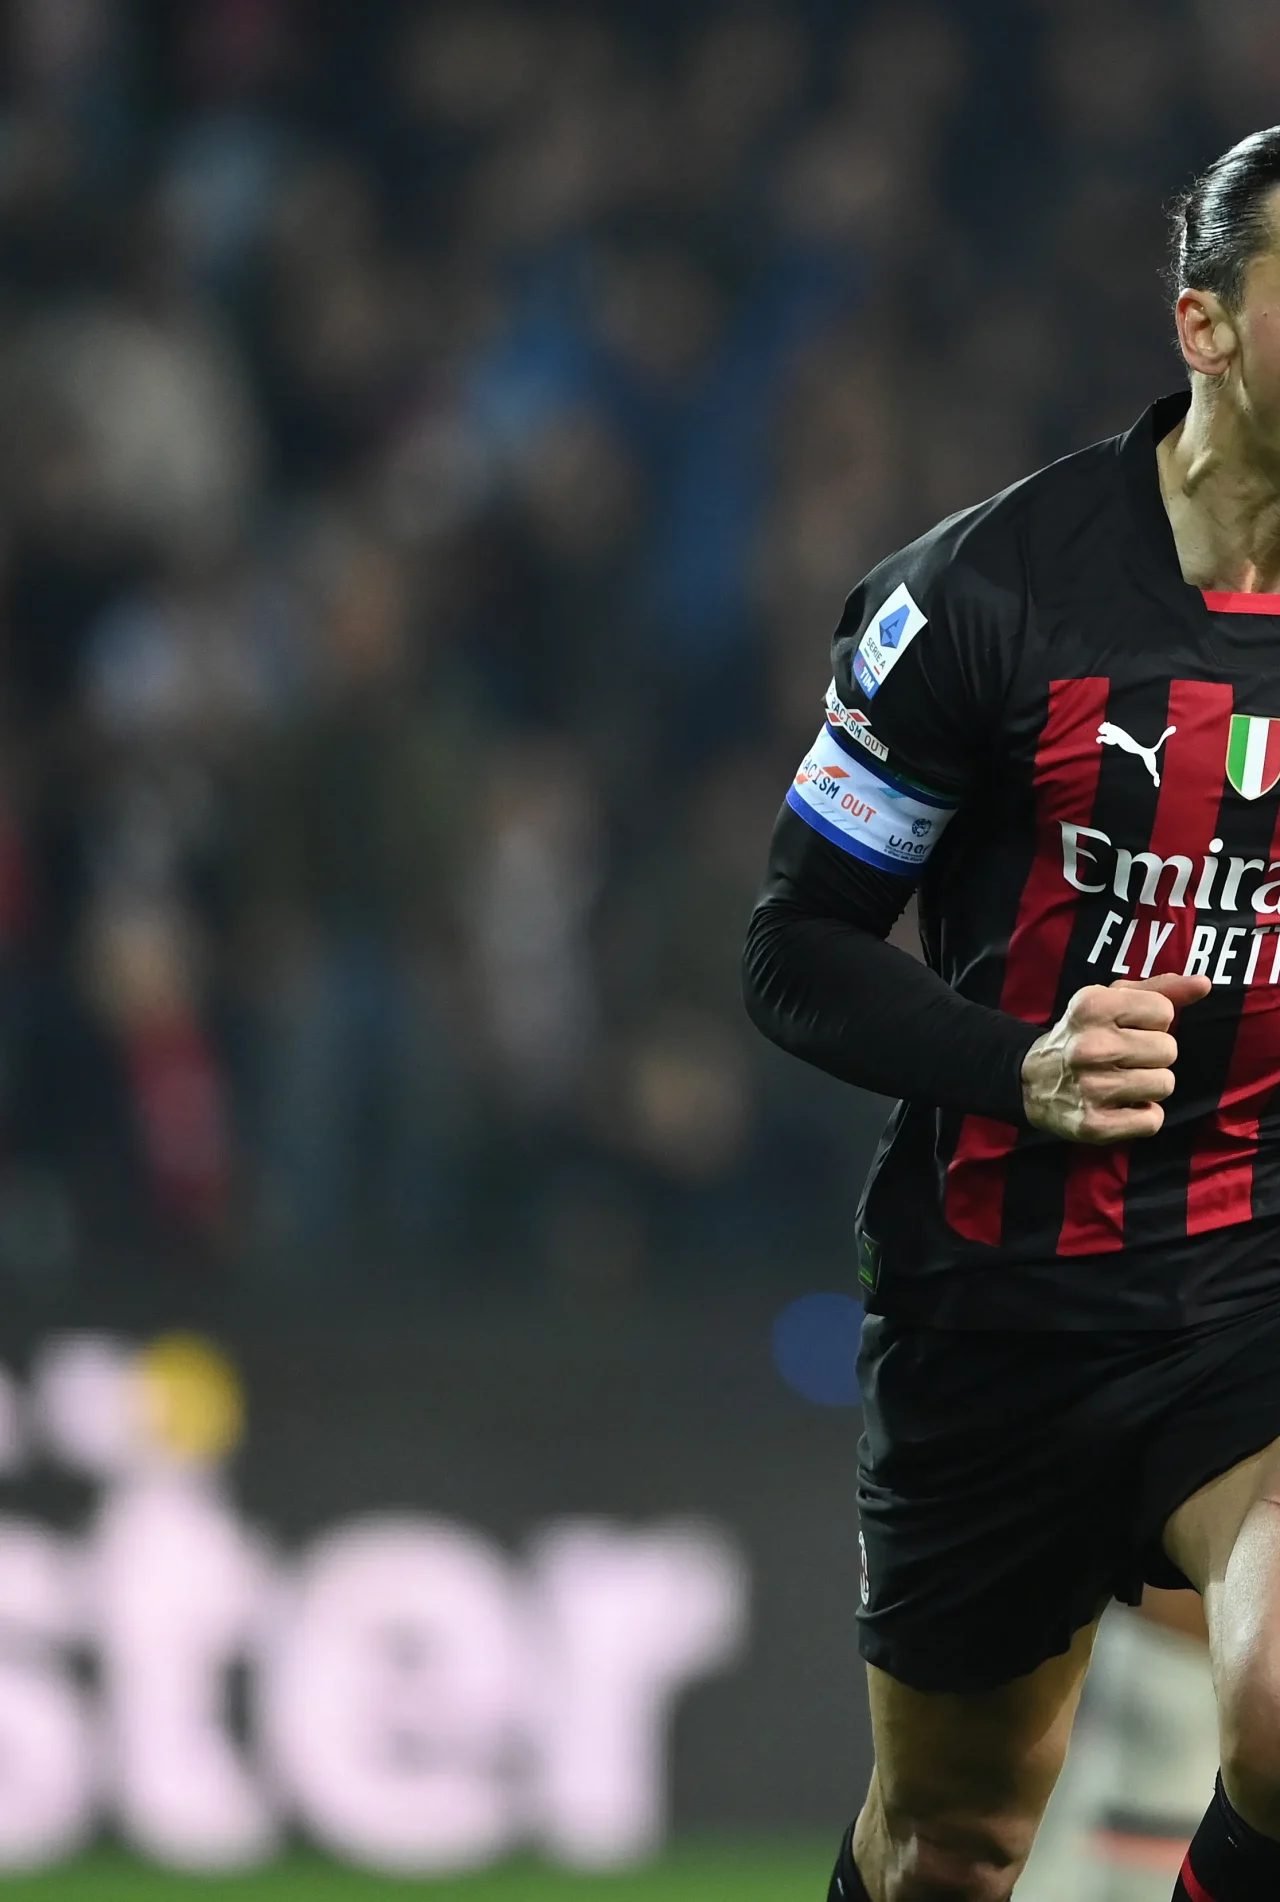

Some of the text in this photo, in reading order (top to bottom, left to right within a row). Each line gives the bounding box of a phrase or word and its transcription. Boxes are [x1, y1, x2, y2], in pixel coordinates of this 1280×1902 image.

[867, 637, 886, 669] SERIE A
[860, 666, 876, 692] TIM
[864, 734, 887, 757] OUT
[803, 757, 877, 823] ACISM OUT
[1086, 909, 1176, 980] FLY
